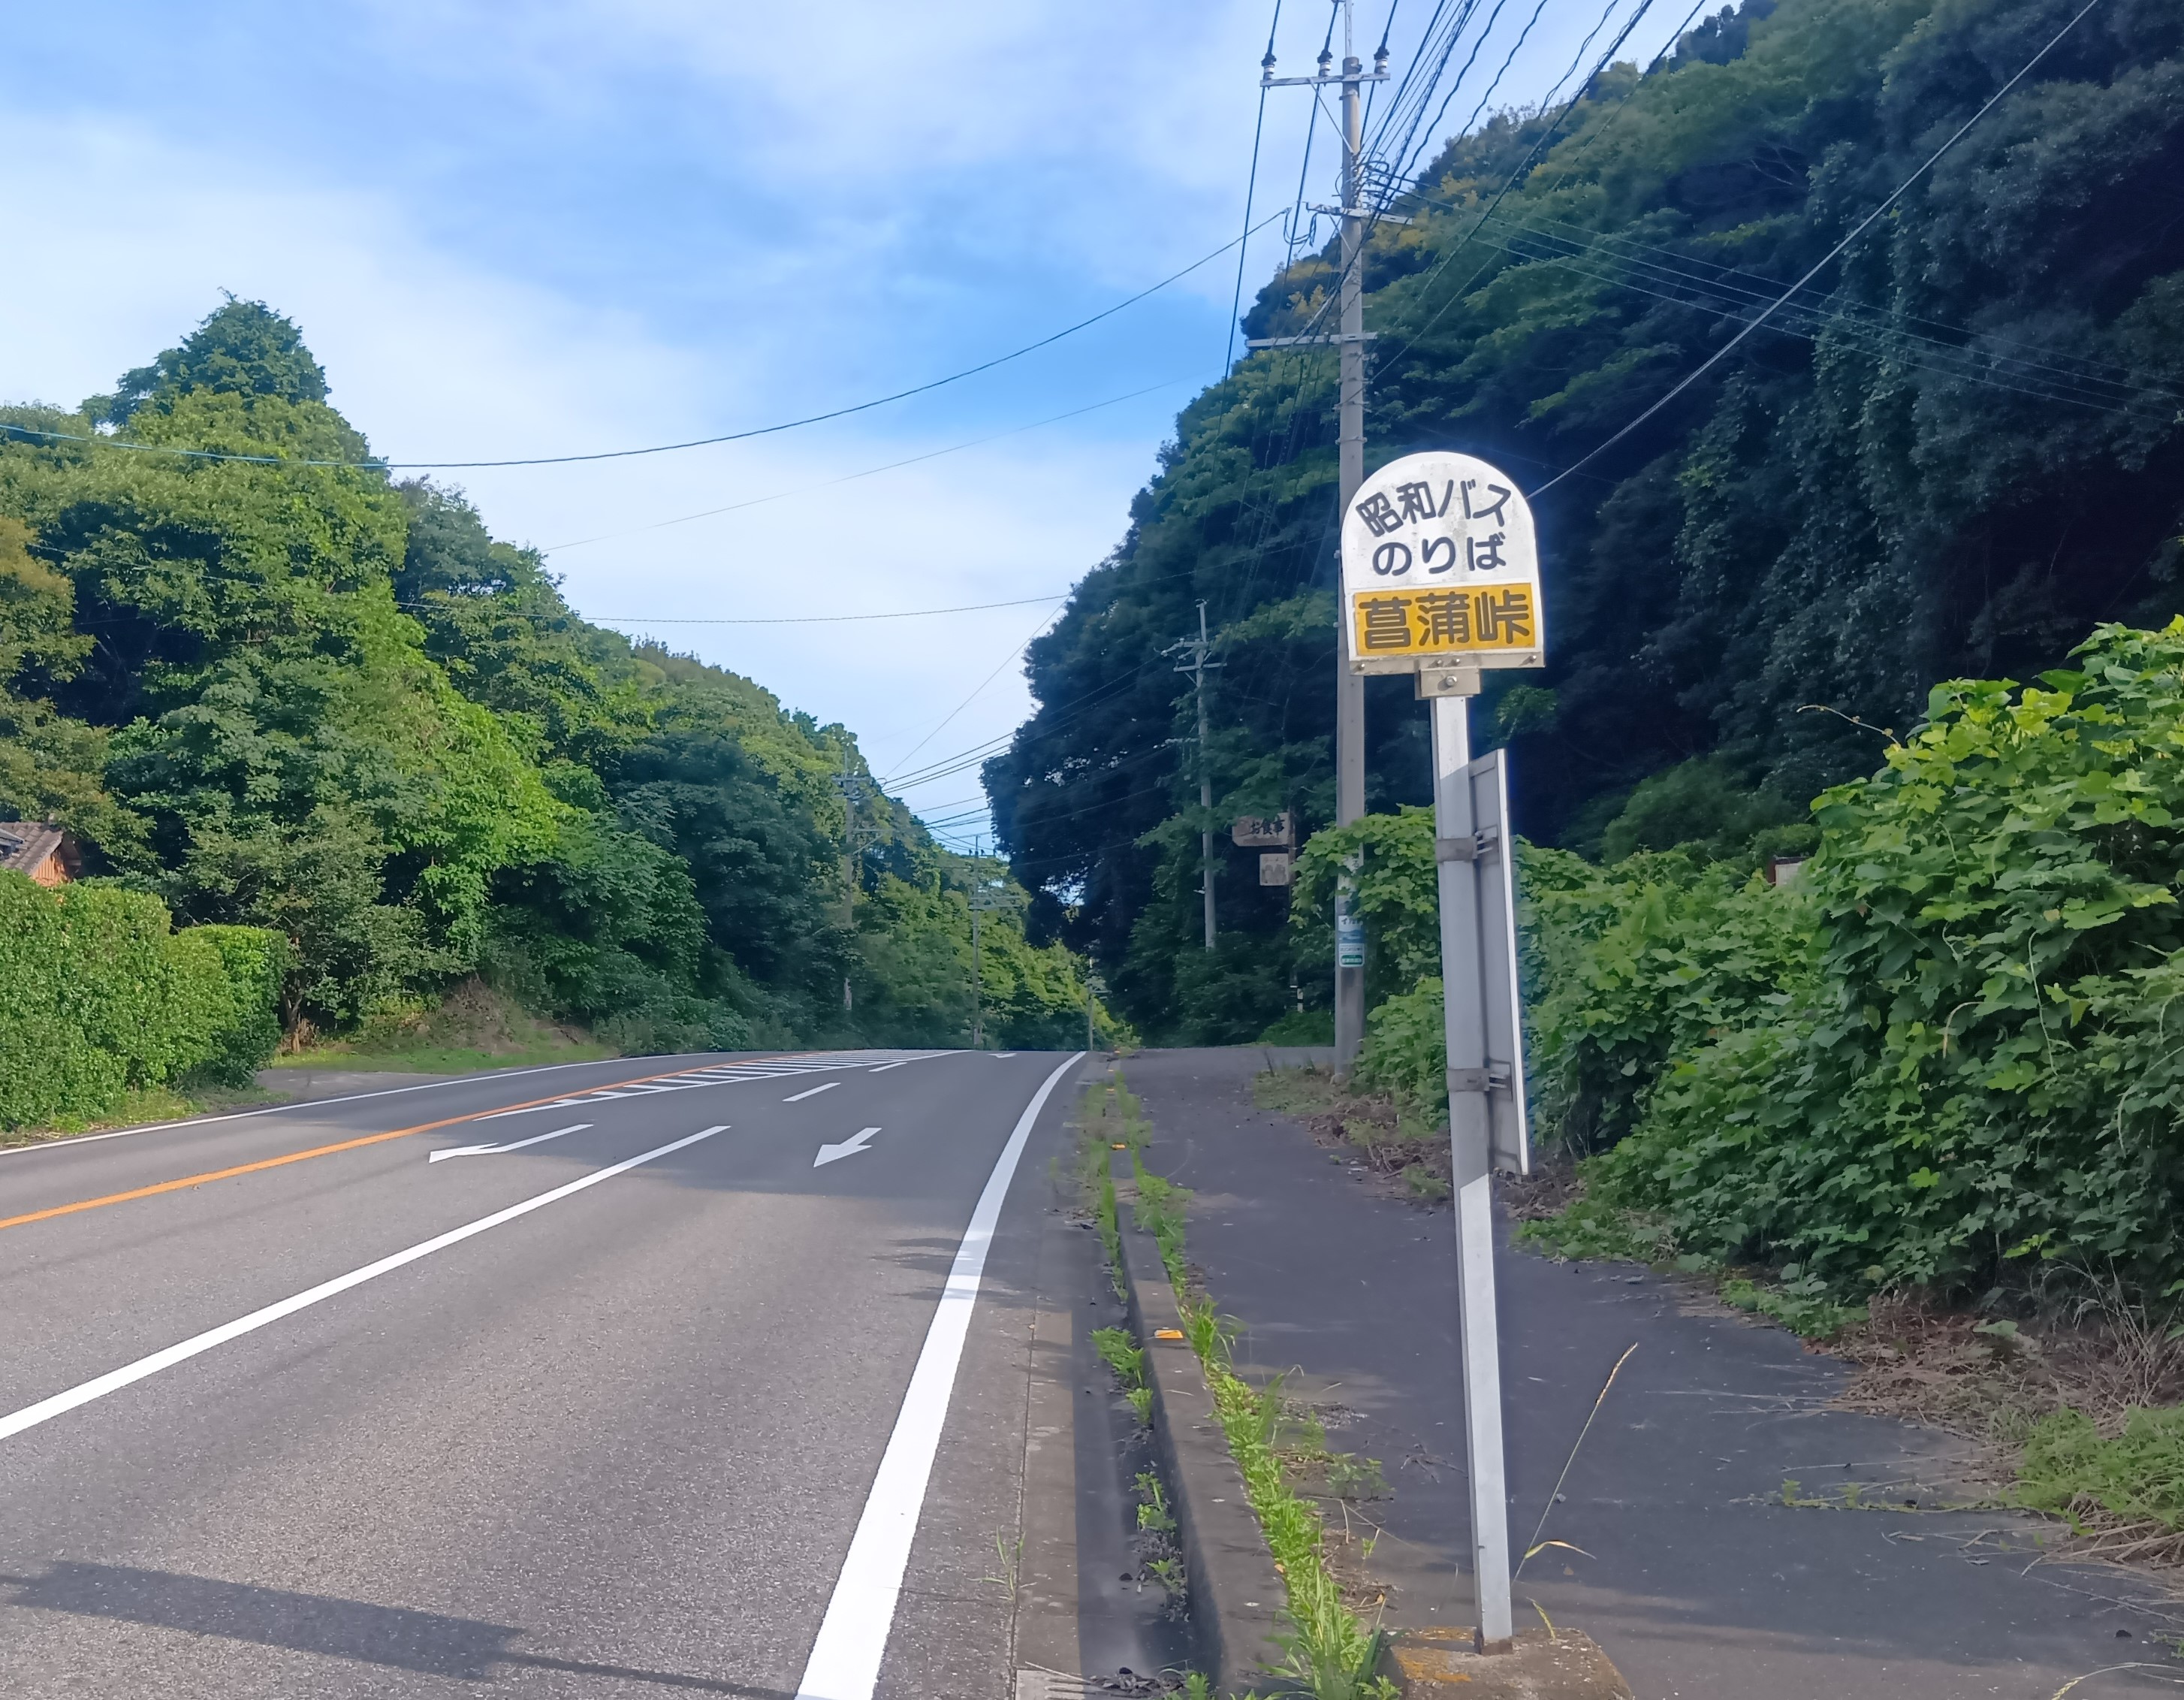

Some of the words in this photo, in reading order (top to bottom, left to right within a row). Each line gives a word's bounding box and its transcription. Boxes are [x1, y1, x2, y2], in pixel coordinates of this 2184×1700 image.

[1356, 479, 1511, 537] 昭和バス
[1372, 532, 1507, 575] のりば
[1359, 590, 1530, 649] 菖蒲峠
